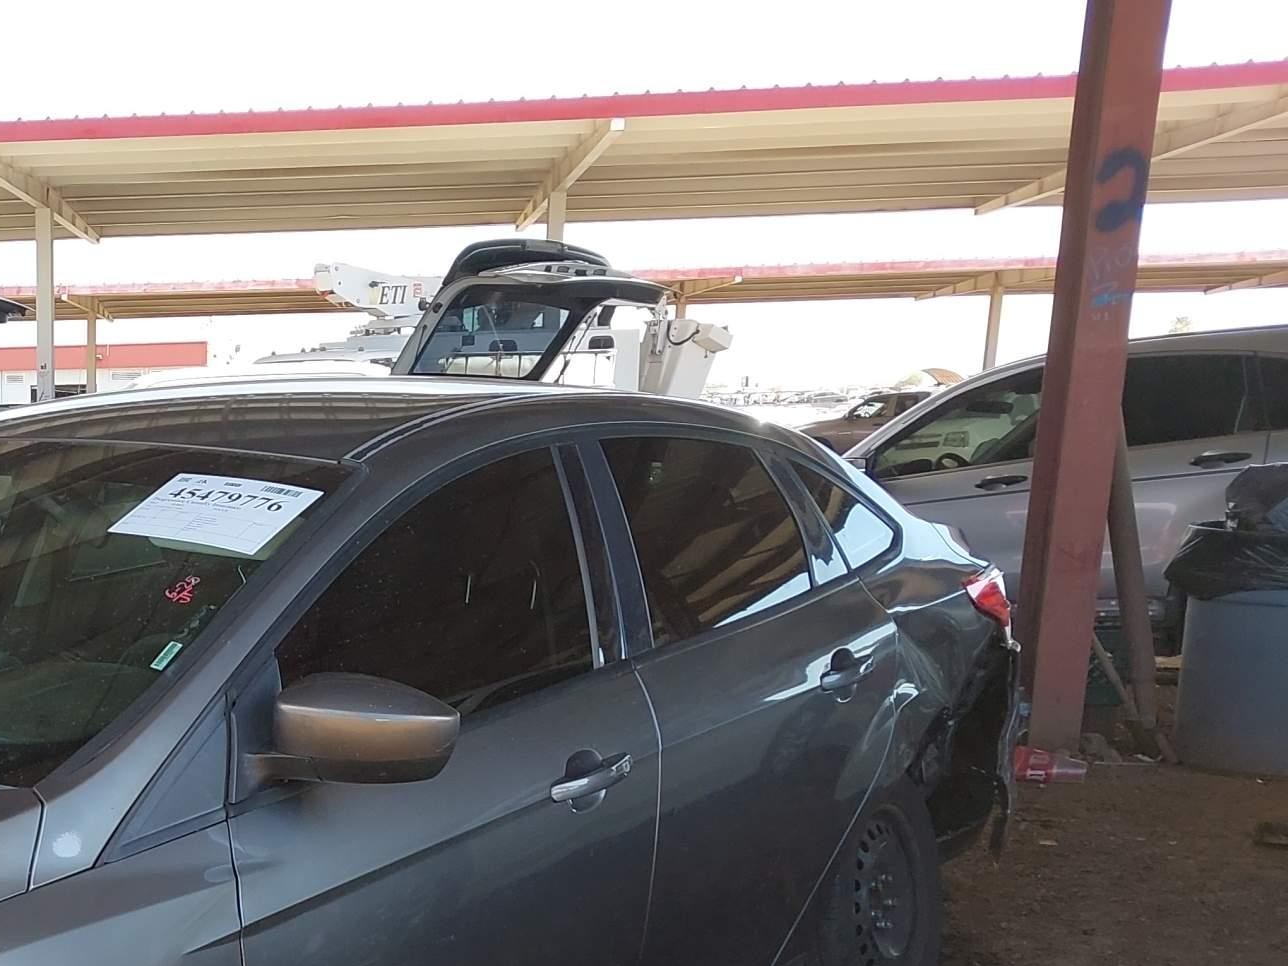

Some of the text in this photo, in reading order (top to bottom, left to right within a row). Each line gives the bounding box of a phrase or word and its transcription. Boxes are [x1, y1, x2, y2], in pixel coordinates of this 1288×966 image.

[1094, 146, 1149, 233] 2
[378, 285, 408, 305] ETI
[169, 486, 287, 513] 45479776
